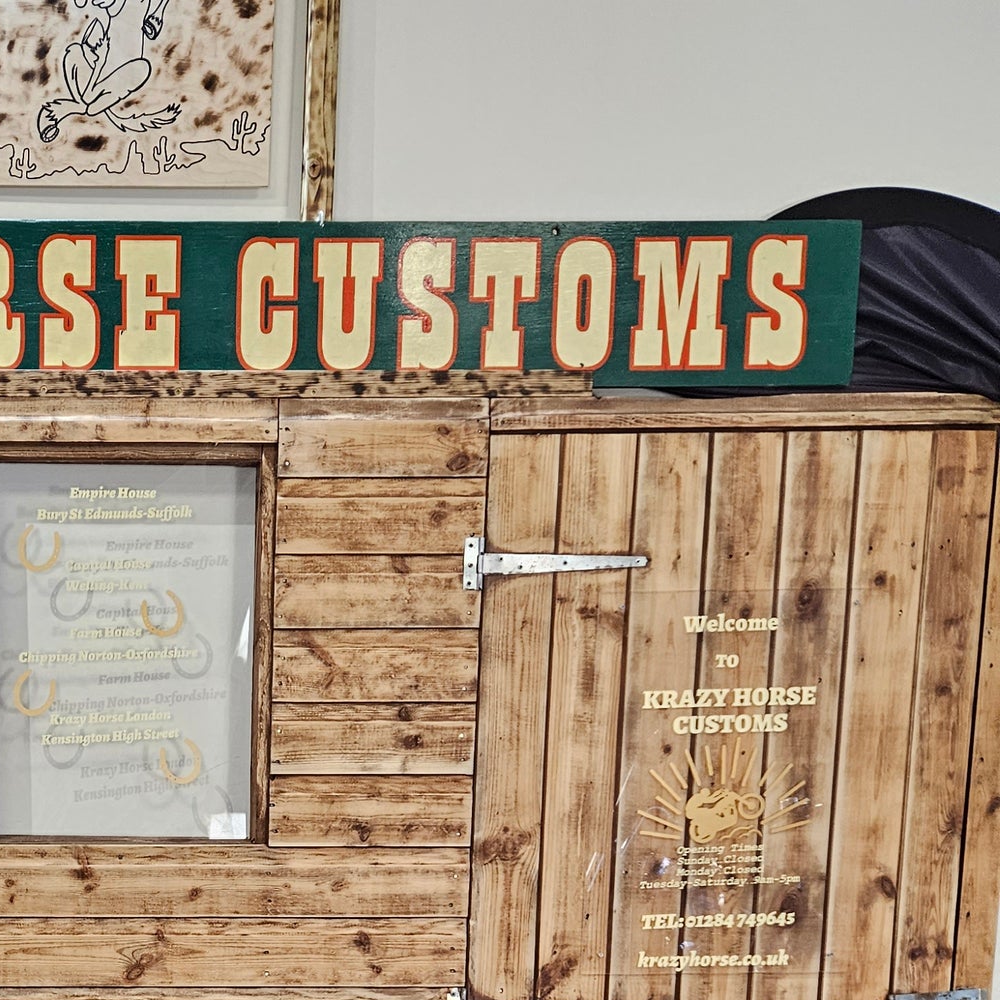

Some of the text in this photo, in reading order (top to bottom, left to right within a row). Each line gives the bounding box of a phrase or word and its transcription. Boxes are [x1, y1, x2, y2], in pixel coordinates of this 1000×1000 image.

[237, 234, 809, 372] CUSTOMS
[69, 487, 157, 501] Empire House
[37, 507, 193, 523] Bury St Edmunds-Suffolk
[683, 613, 779, 633] Welcome
[19, 651, 77, 666] Chipping
[715, 654, 739, 668] TO
[642, 686, 817, 710] KRAZY HORSE
[50, 710, 172, 727] Krazy Horse London
[673, 713, 788, 735] CUSTOMS
[41, 727, 180, 746] Kensington High Street
[677, 844, 764, 856] Opening Times
[736, 911, 796, 927] 749645
[637, 949, 790, 972] krazyhorse.co.uk
